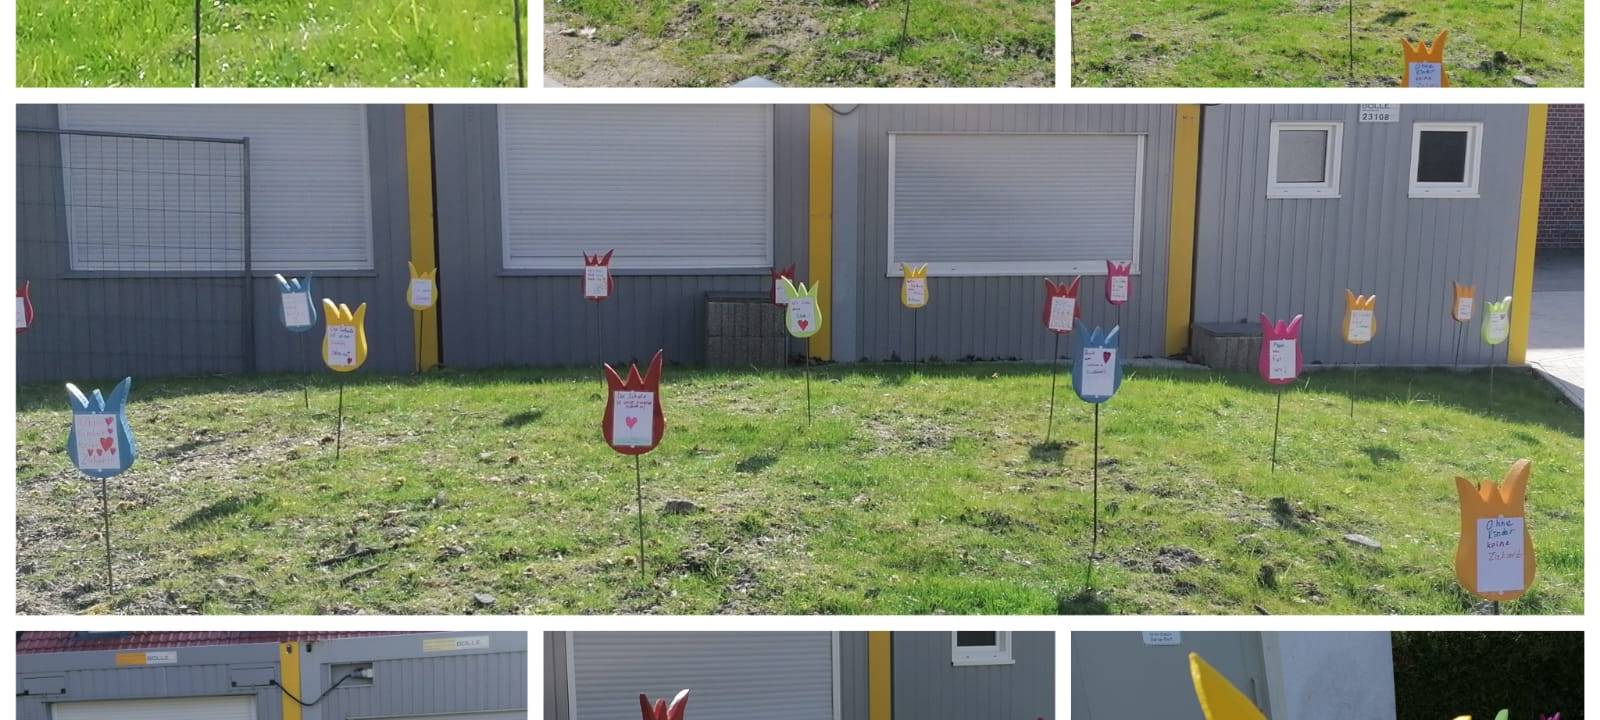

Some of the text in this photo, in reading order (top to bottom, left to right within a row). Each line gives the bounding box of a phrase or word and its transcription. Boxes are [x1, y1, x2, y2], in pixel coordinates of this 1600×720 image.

[1361, 112, 1391, 121] 23108
[1486, 519, 1514, 531] Ohne
[1486, 540, 1511, 549] keine
